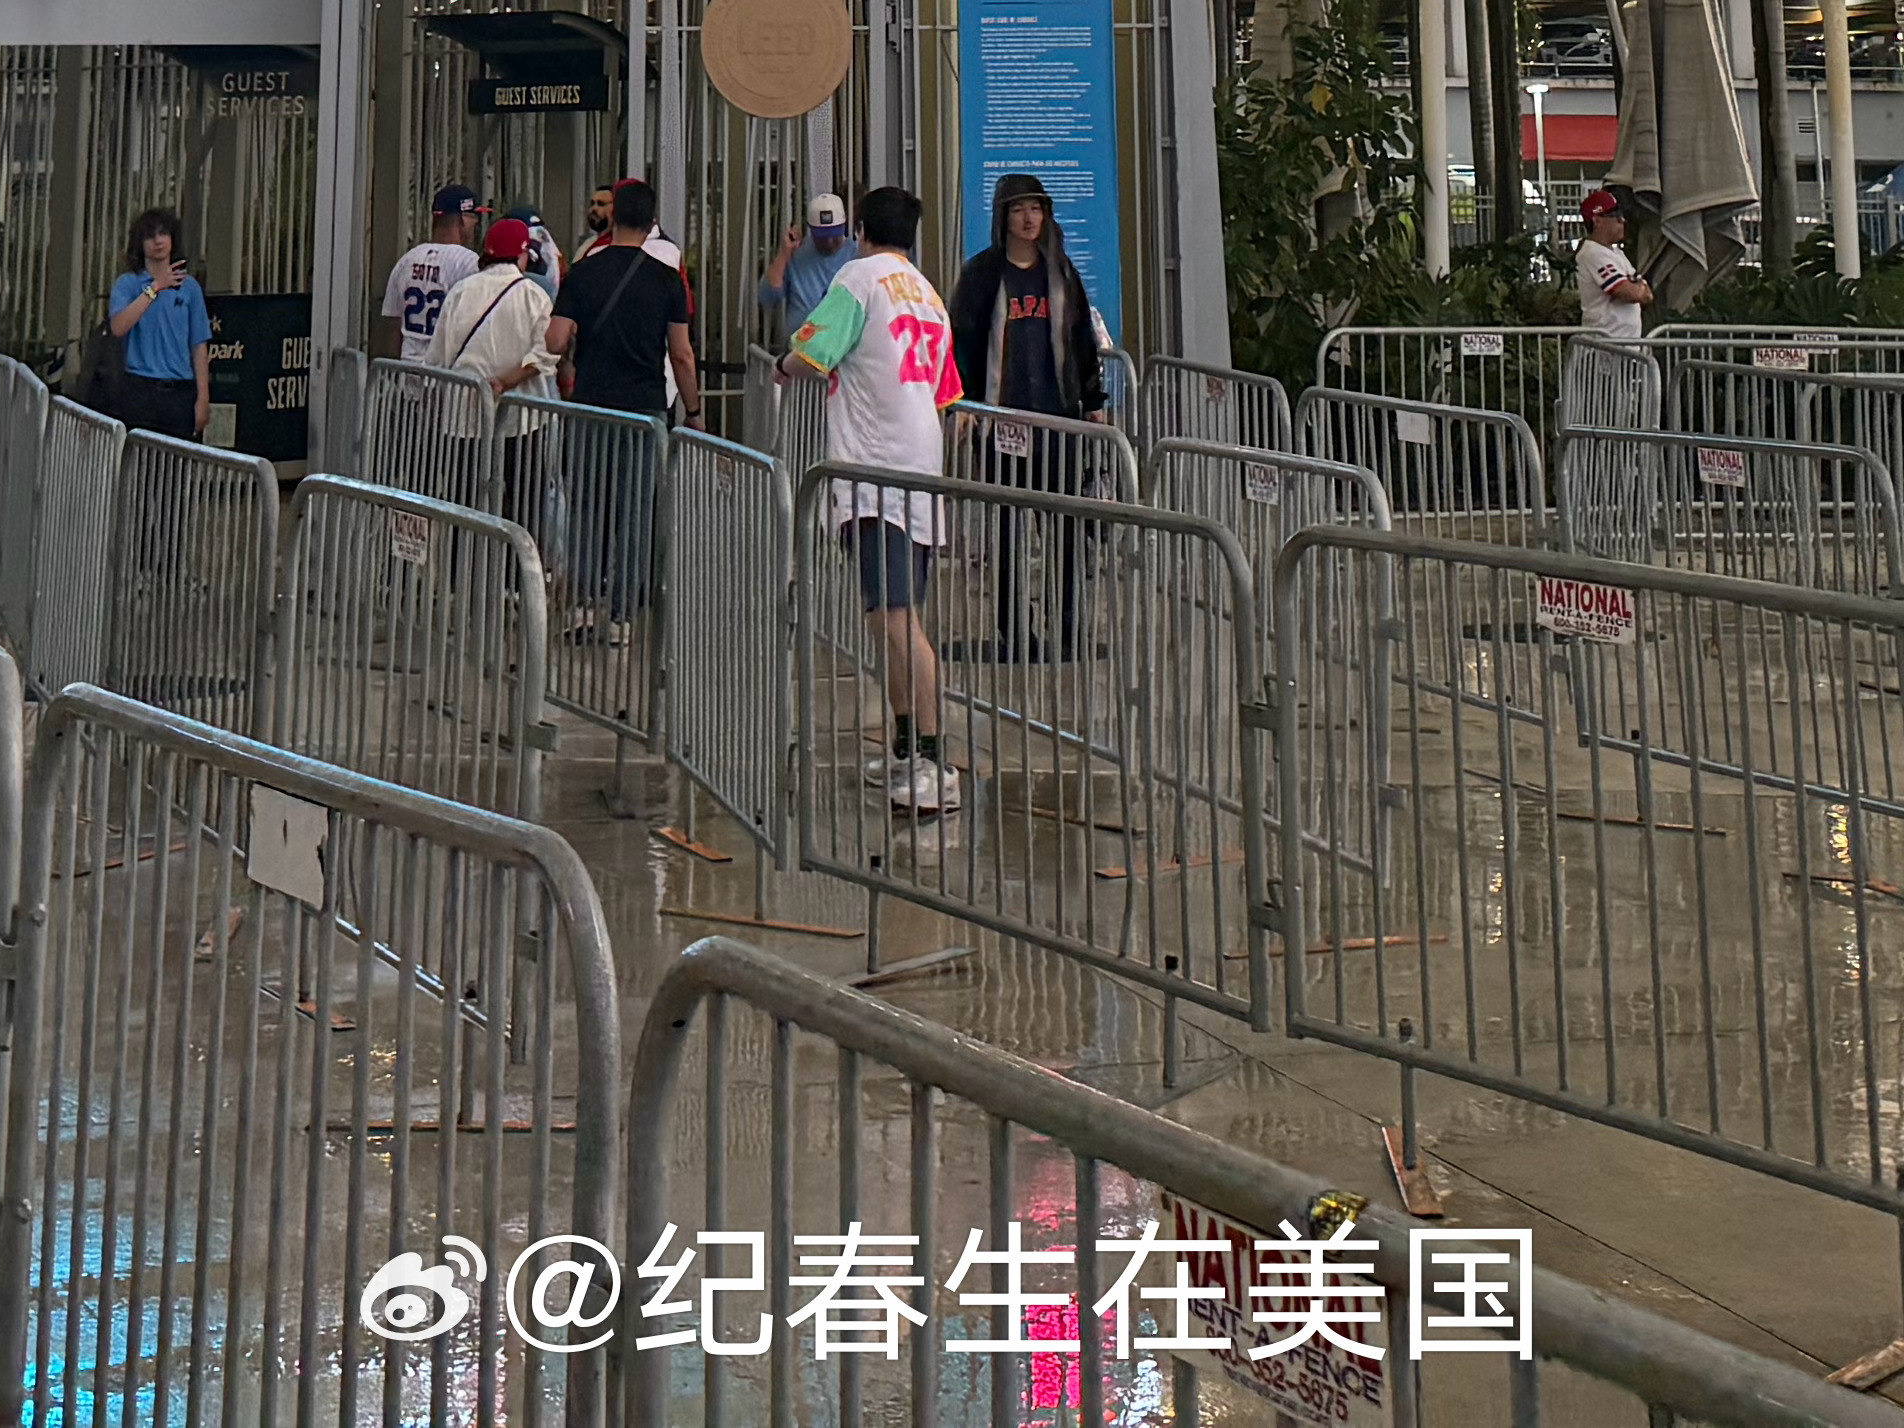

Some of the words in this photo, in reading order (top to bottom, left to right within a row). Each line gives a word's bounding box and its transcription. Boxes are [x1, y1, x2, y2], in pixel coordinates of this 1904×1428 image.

[222, 71, 290, 93] GUEST
[494, 86, 527, 106] GUEST
[529, 84, 581, 105] SERVICES
[206, 95, 305, 118] SERVICES
[1756, 348, 1807, 363] NATIONAL
[266, 375, 308, 410] SERV
[1540, 577, 1633, 620] NATIONAL
